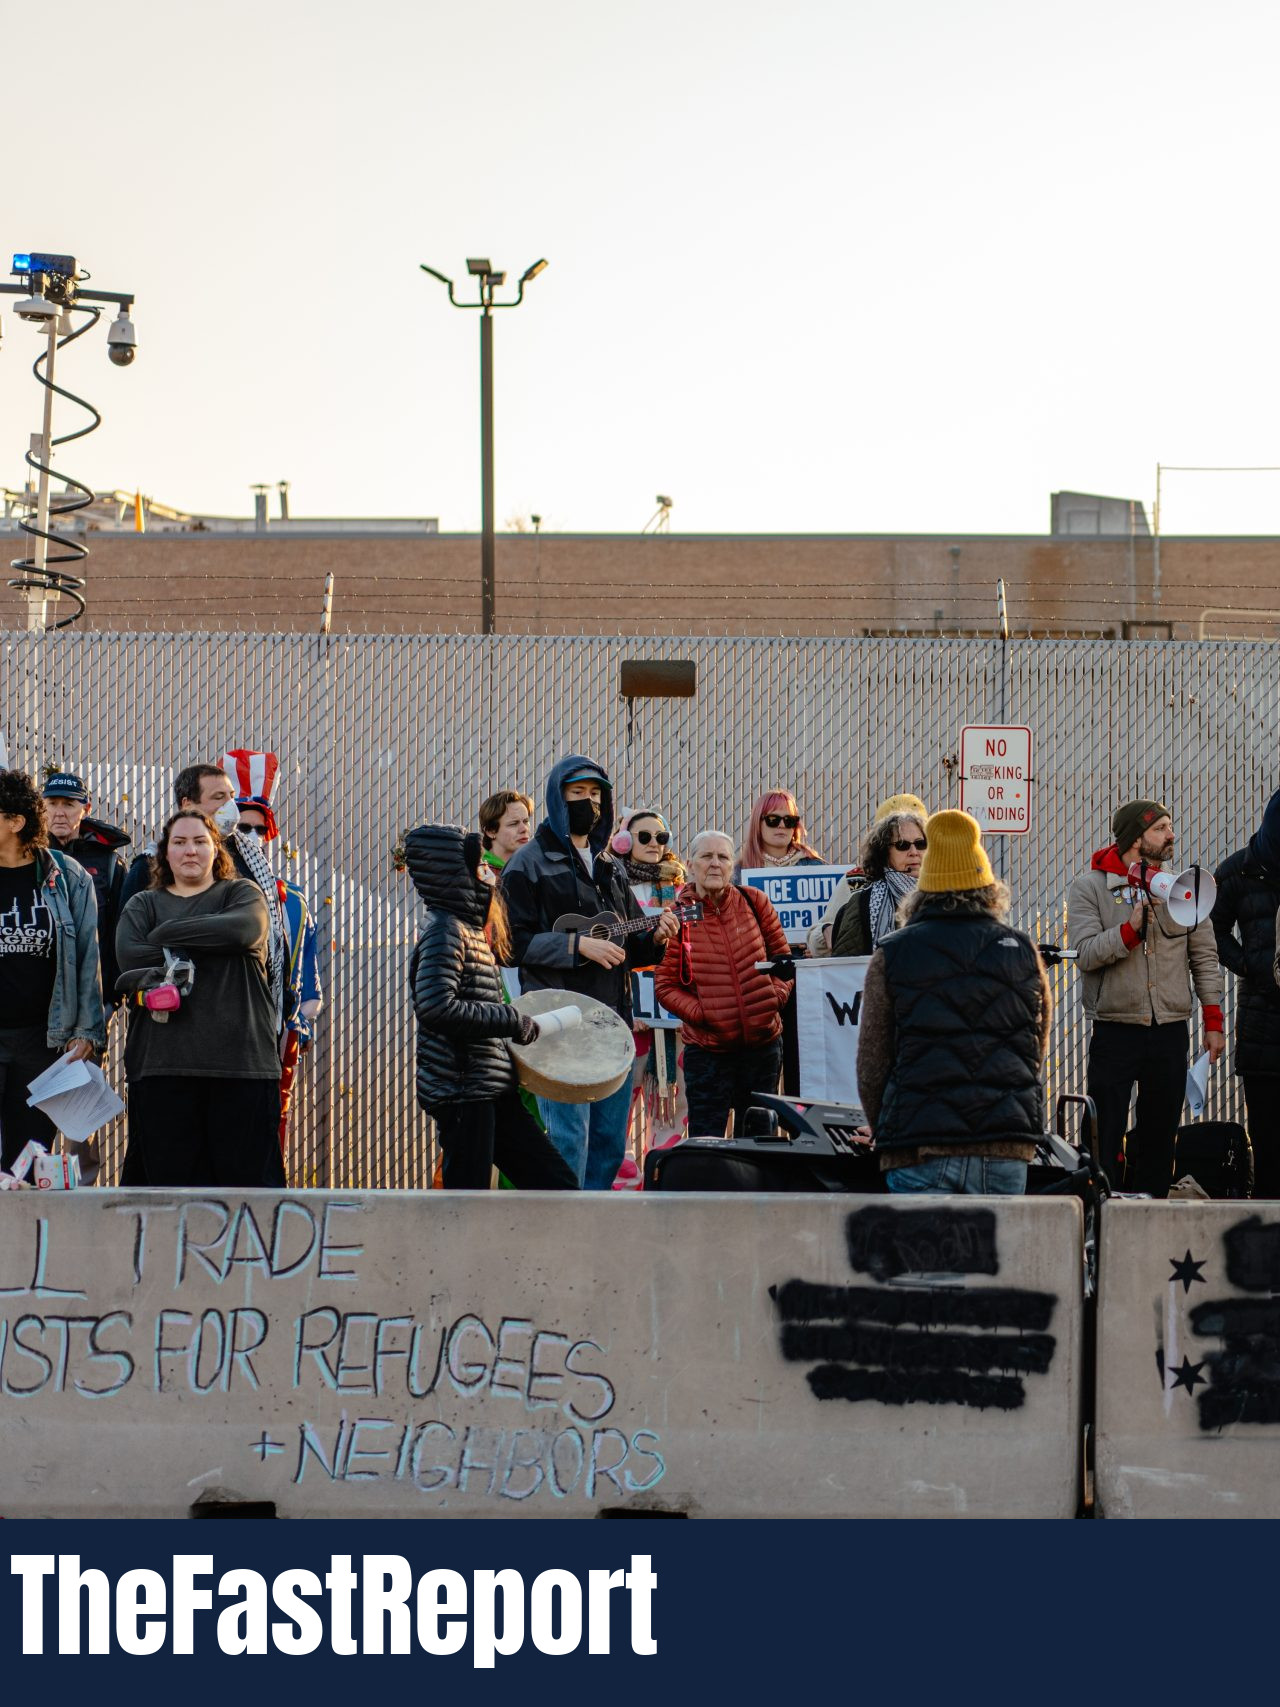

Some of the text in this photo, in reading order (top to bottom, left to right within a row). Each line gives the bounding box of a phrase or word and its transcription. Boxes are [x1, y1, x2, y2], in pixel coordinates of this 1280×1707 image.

[986, 739, 1007, 756] NO
[971, 765, 1023, 780] KING
[988, 787, 1004, 800] OR
[763, 879, 793, 903] ICE
[0, 927, 48, 938] CAGO
[103, 1200, 366, 1289] TRADE
[154, 1307, 269, 1395] FOR
[293, 1305, 617, 1428] REFUGEES
